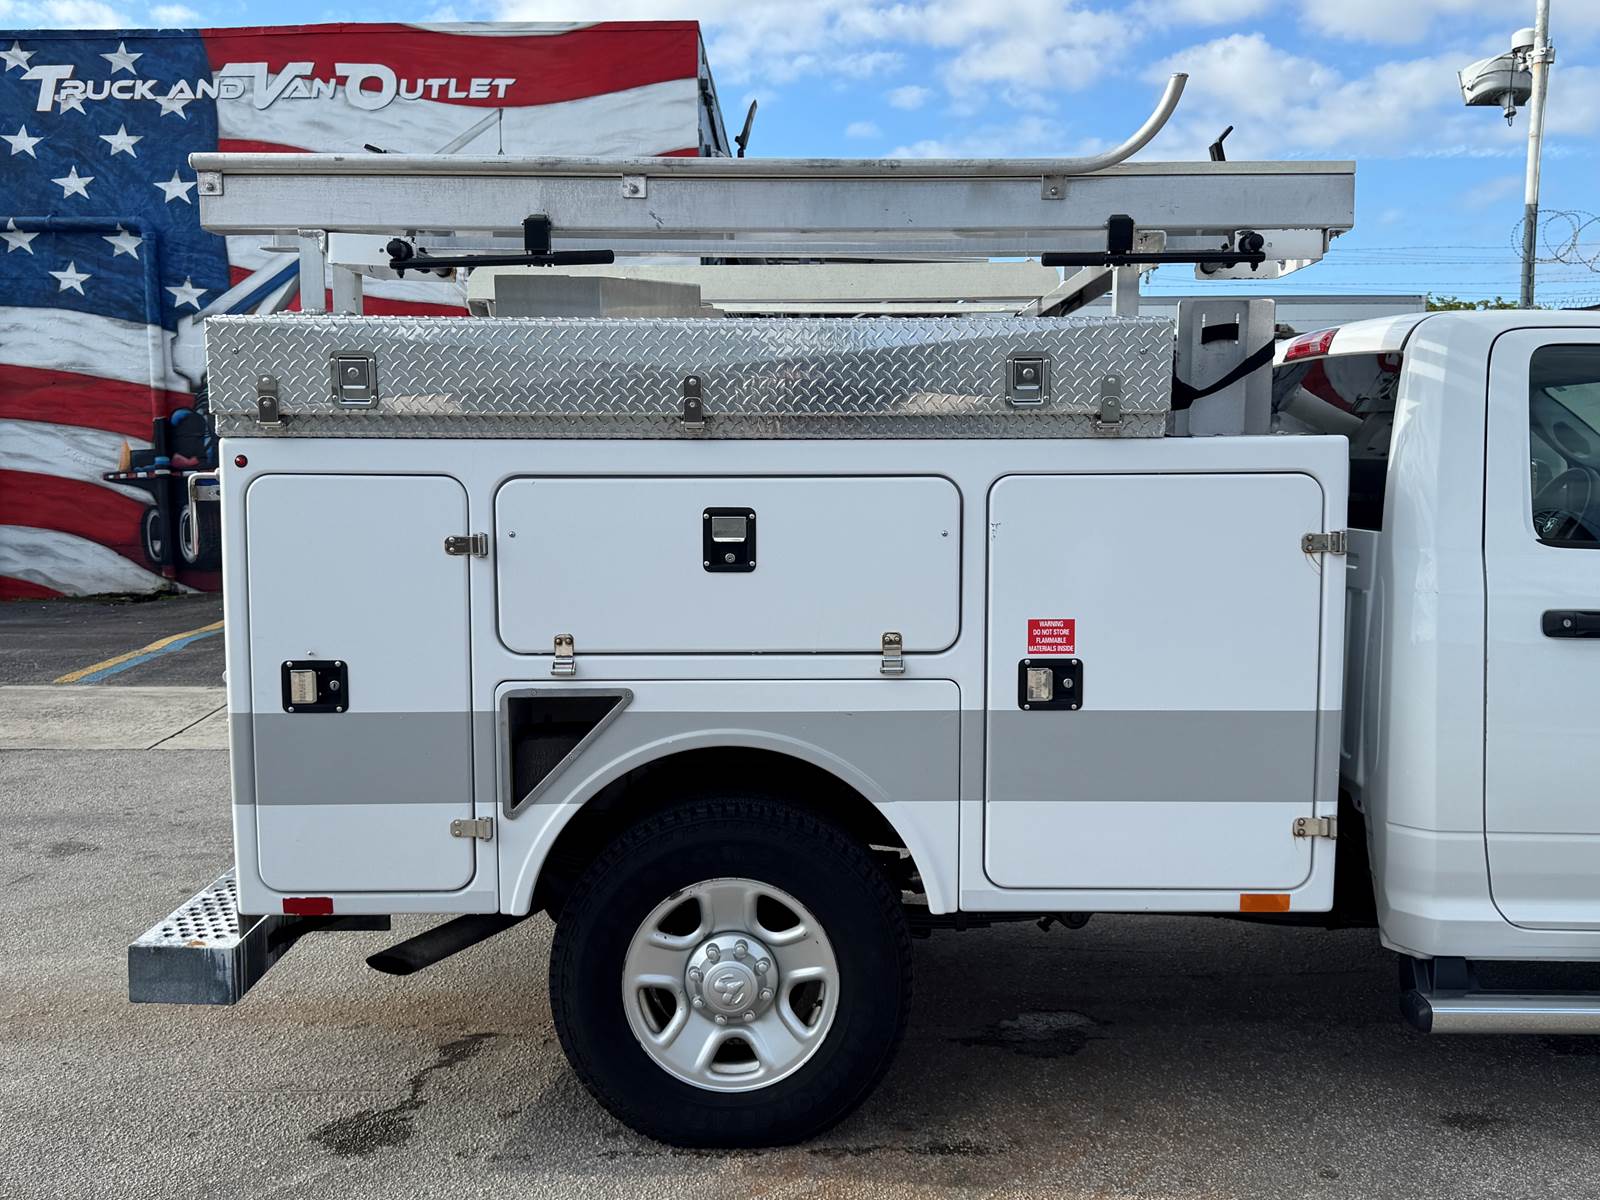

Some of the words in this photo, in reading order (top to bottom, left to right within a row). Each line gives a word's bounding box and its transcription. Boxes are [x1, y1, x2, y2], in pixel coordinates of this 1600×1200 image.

[20, 64, 157, 112] TRUCK
[166, 78, 246, 100] AND
[335, 62, 518, 112] OUTLET
